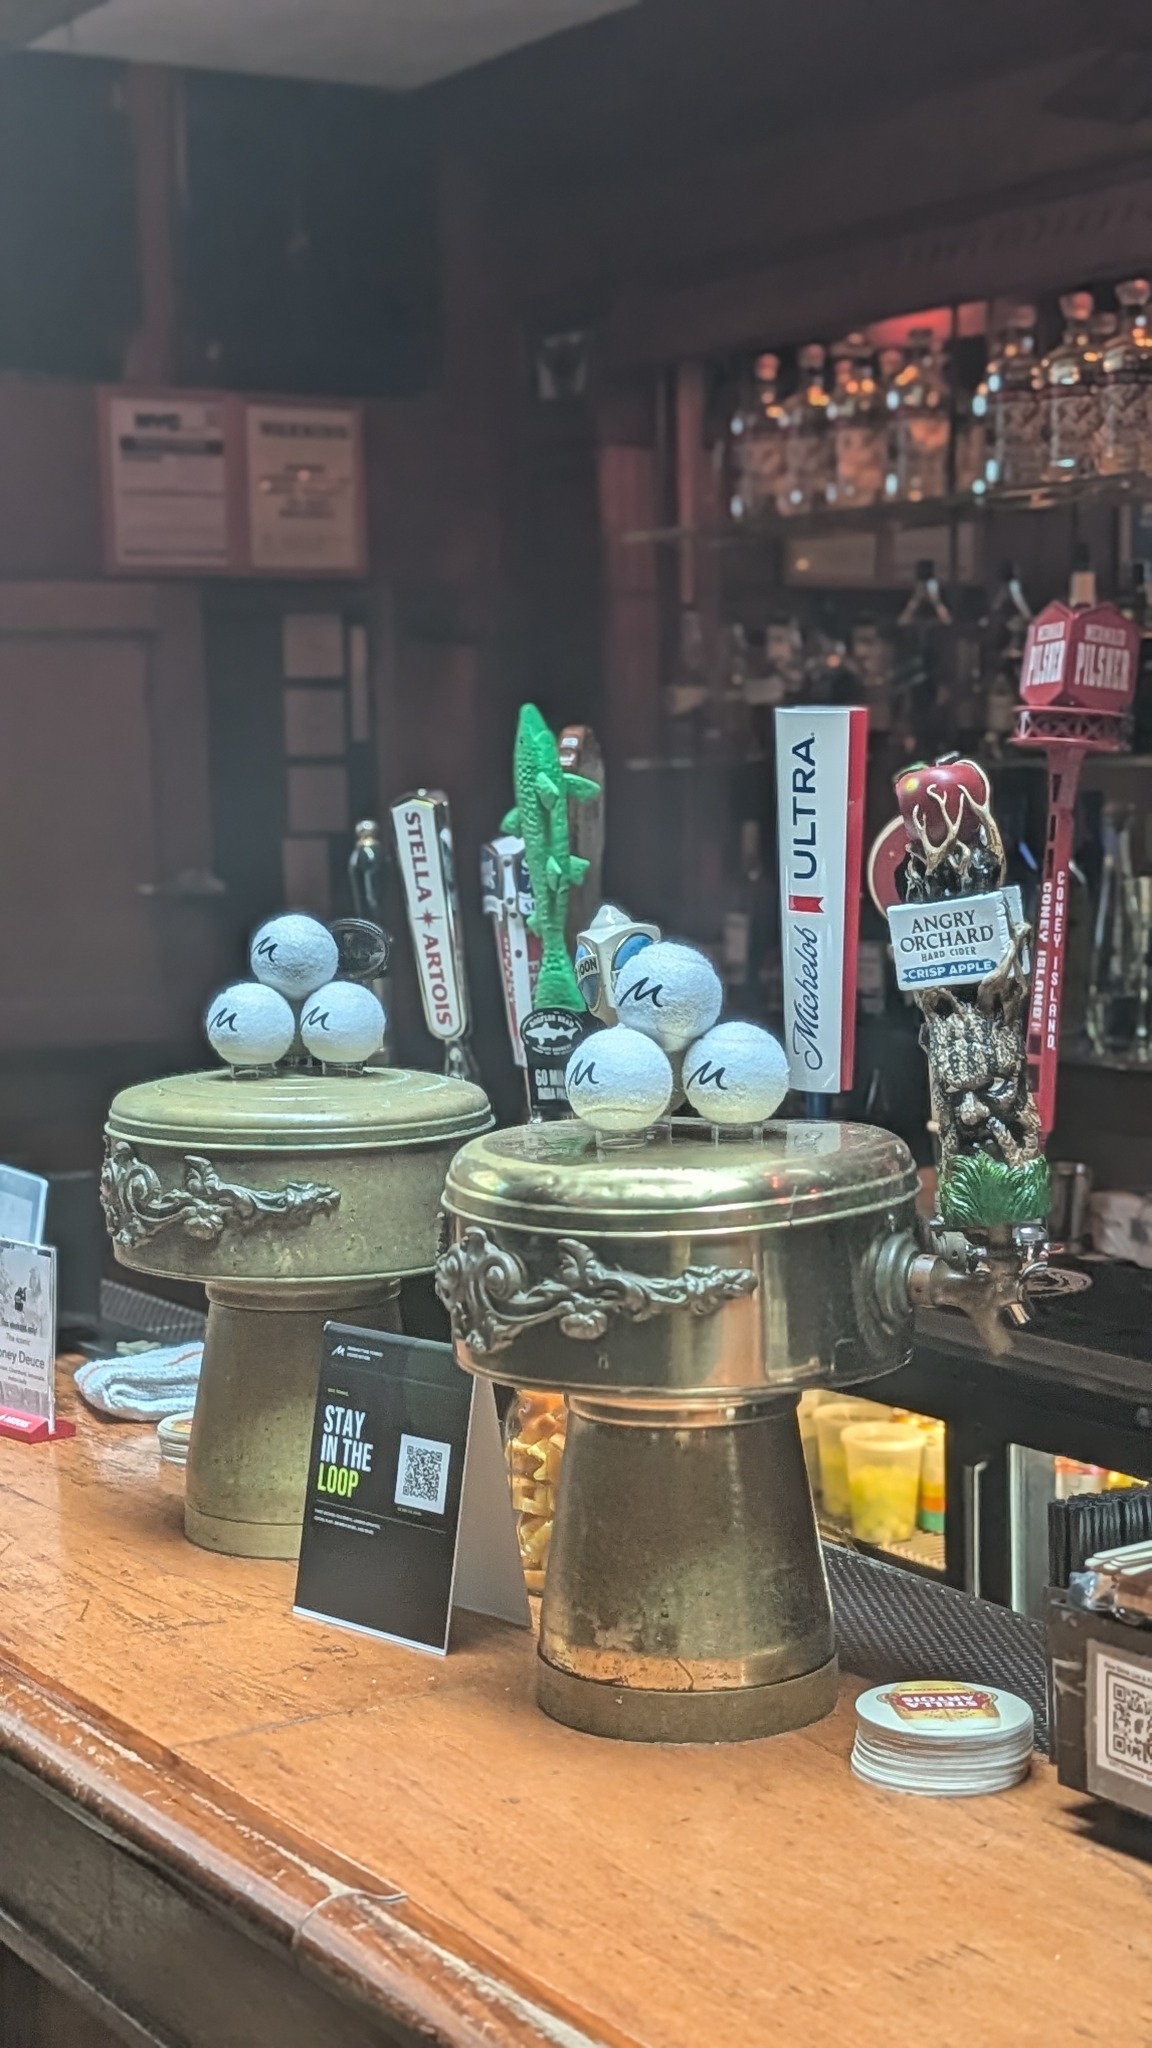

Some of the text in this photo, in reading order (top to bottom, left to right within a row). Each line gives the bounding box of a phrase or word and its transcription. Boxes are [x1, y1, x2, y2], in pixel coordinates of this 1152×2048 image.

[1075, 642, 1130, 691] PILSNER
[404, 812, 453, 1026] STELLA ARTOIS
[792, 736, 824, 1071] Michelob ULTRA
[1038, 882, 1053, 943] CONEY
[900, 925, 994, 953] ORCHARD
[911, 909, 976, 935] ANGRY
[579, 957, 598, 978] OON
[908, 960, 993, 980] CRISP APPLE
[921, 946, 977, 963] HARD CIDER
[1047, 871, 1066, 1050] CONEY ISLAND
[535, 1069, 548, 1086] 60
[18, 1350, 45, 1369] Deuce
[323, 1404, 366, 1439] STAY
[320, 1433, 374, 1472] IN THE
[317, 1462, 359, 1498] LOOP
